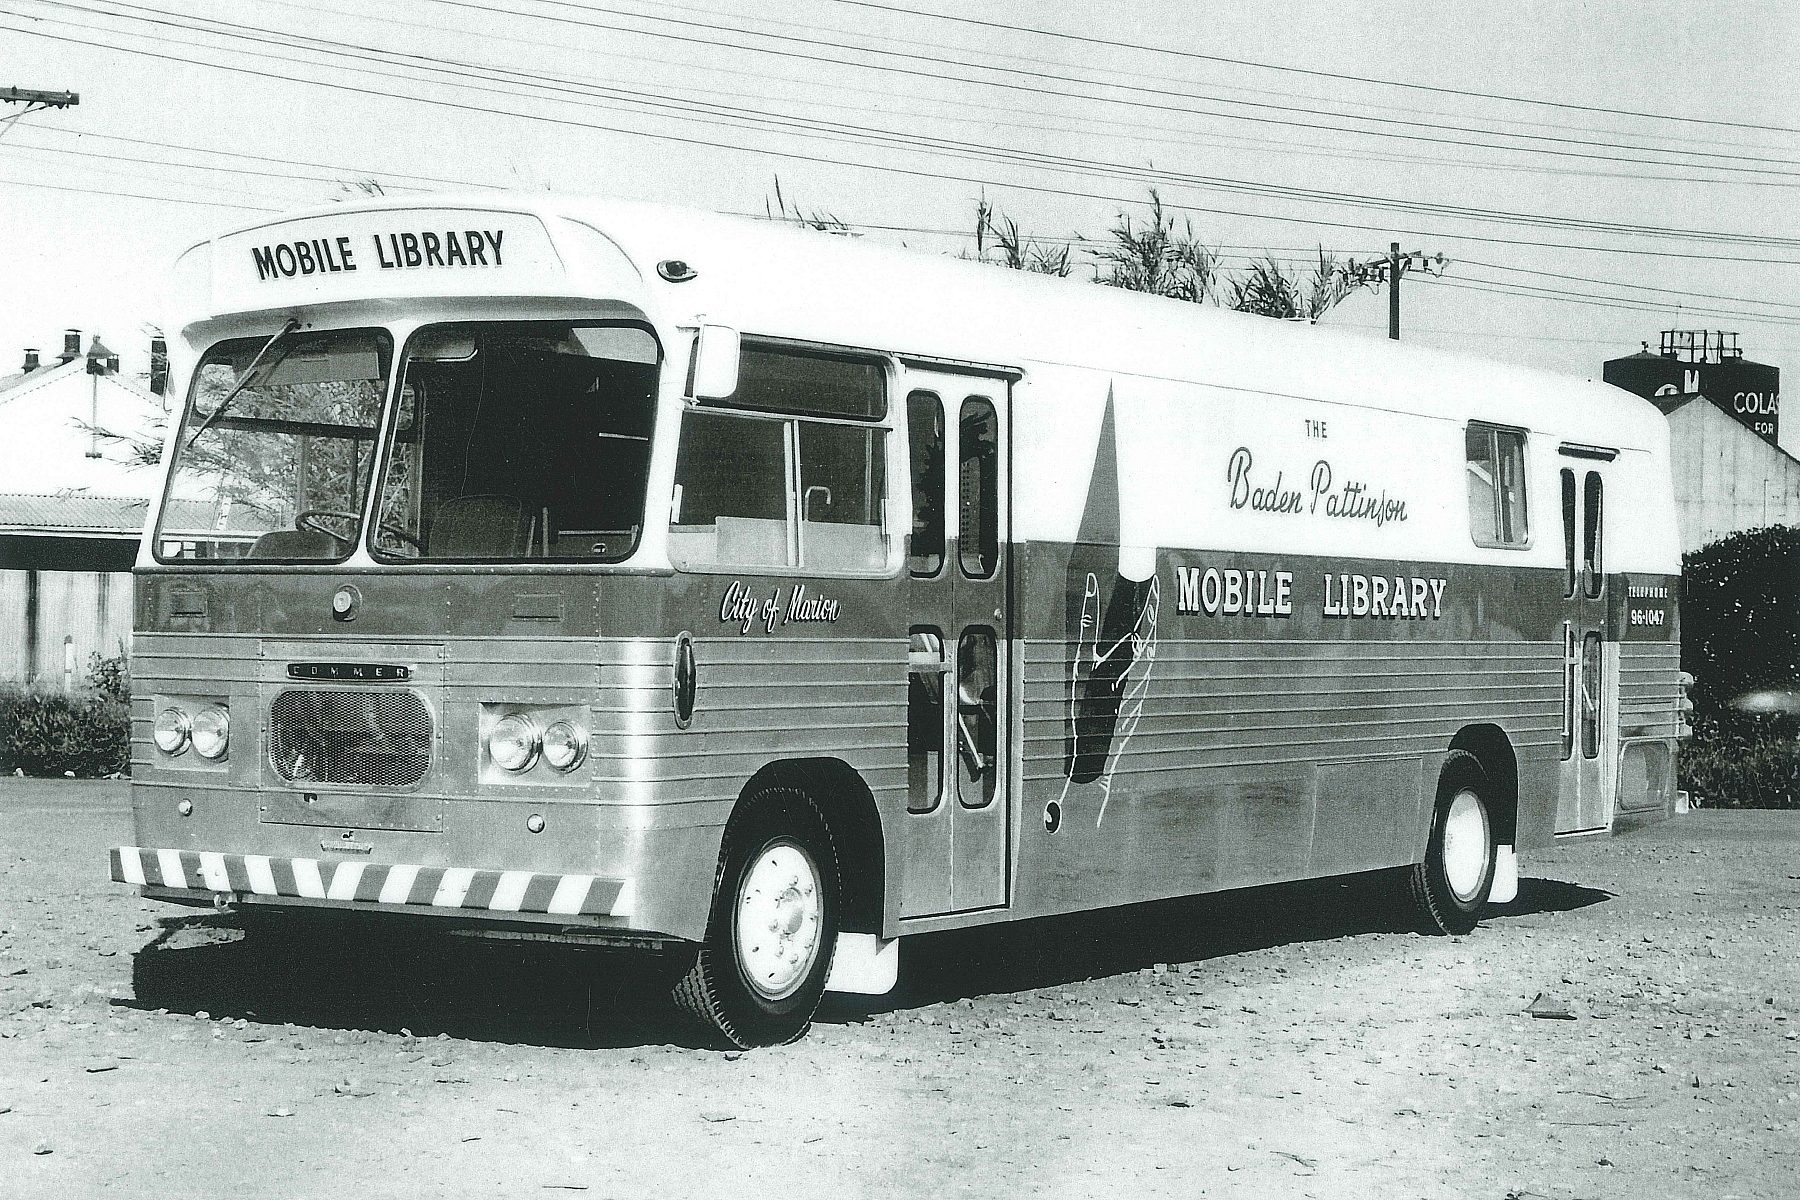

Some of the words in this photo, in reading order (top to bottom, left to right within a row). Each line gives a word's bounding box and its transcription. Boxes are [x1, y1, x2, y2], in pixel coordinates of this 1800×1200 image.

[252, 236, 357, 281] MOBILE
[373, 230, 504, 269] LIBRARY
[1304, 419, 1328, 439] THE
[1754, 422, 1774, 435] FOR
[1227, 446, 1303, 515] Baden
[1309, 459, 1408, 528] Pattinson
[720, 580, 759, 635] City
[761, 587, 781, 634] of
[781, 584, 842, 626] Marion
[1176, 566, 1294, 616] MOBILE
[1322, 573, 1448, 619] LIBRARY
[1627, 586, 1668, 599] TELEPHONE
[293, 665, 404, 678] COMMER
